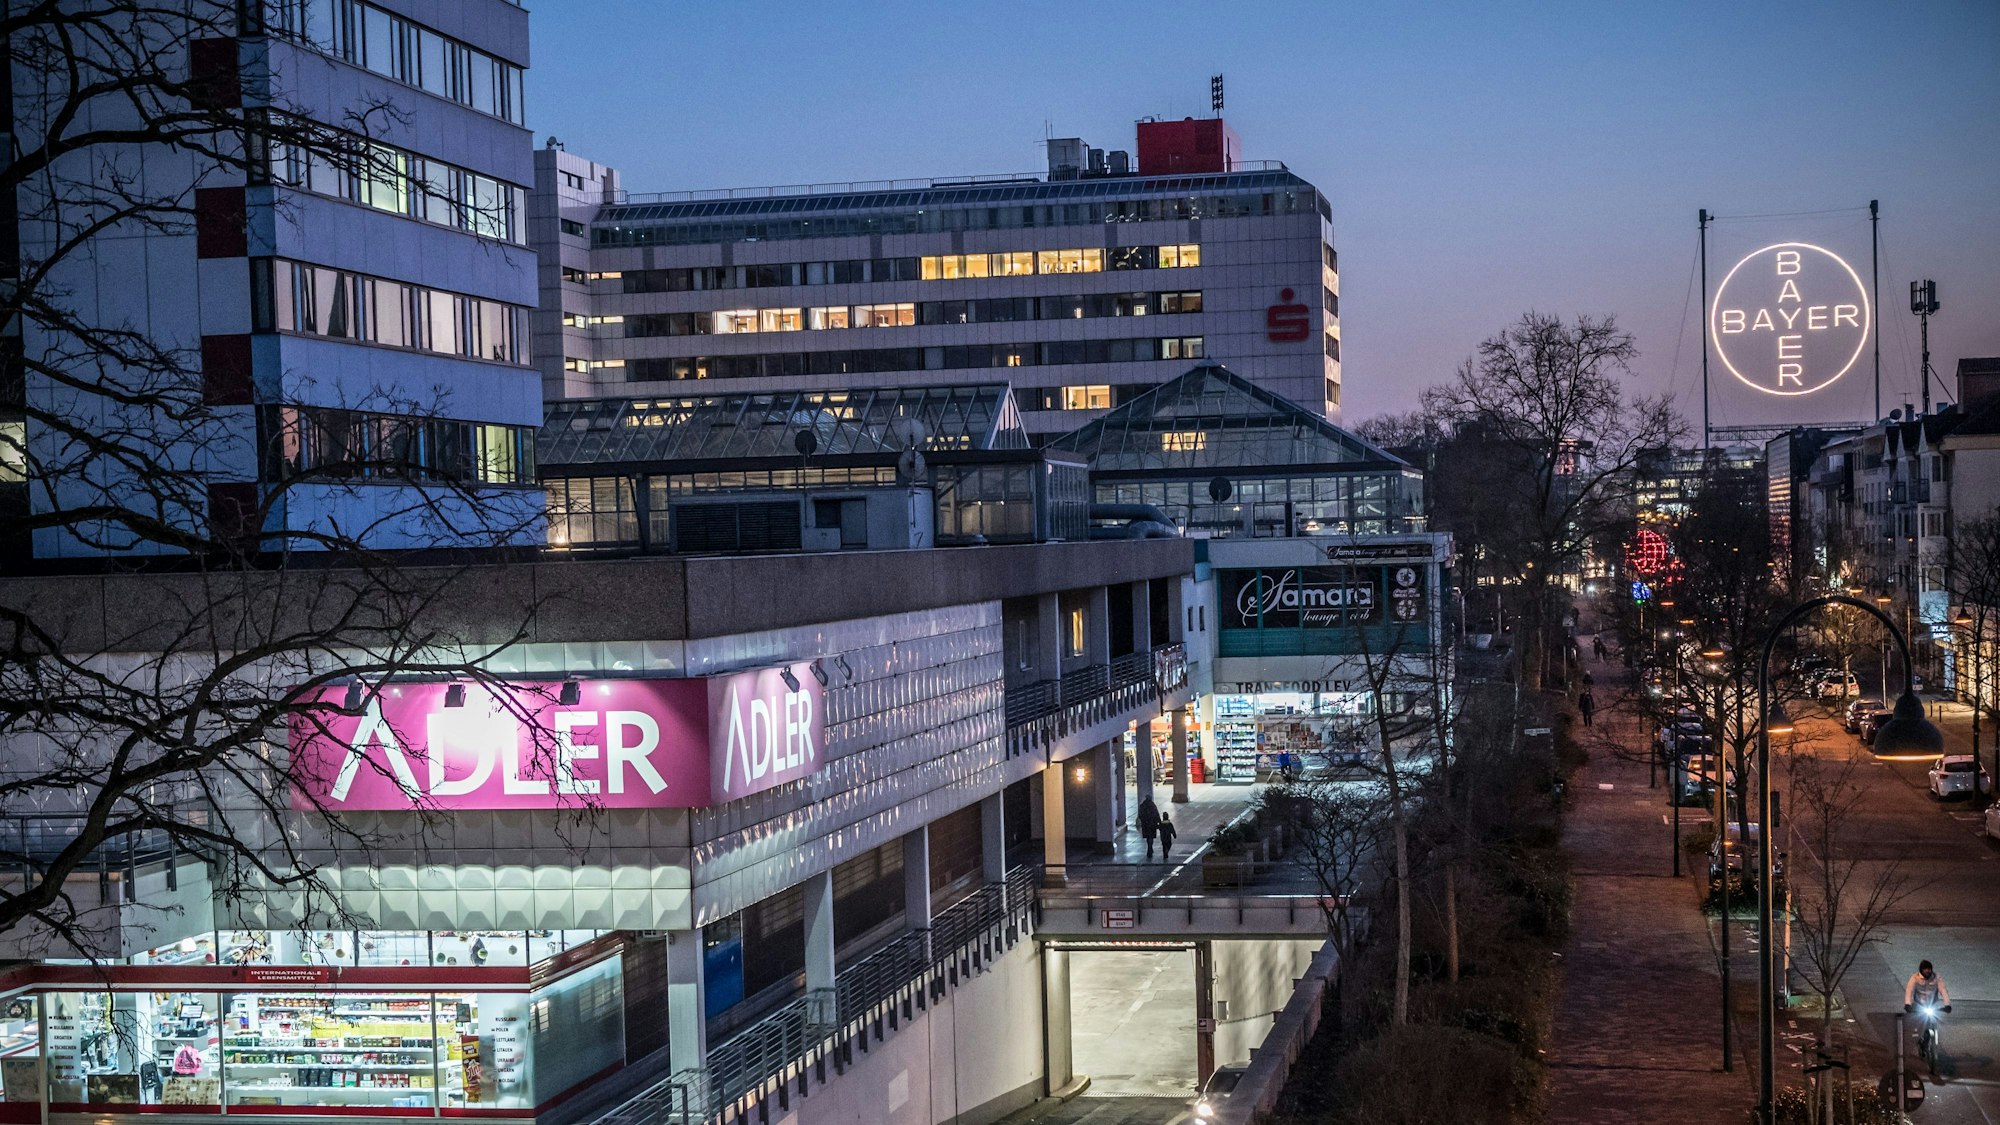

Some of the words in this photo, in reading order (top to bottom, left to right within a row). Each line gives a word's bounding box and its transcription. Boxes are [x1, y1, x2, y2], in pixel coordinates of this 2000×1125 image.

[1722, 304, 1859, 333] BAYER
[1777, 251, 1803, 387] BAYER
[1327, 547, 1361, 557] Samaa
[1237, 569, 1371, 626] Samara
[1303, 610, 1339, 627] lounge
[1236, 681, 1321, 694] TRANSFOOD
[1326, 681, 1351, 692] LEV
[330, 694, 668, 802] ADLER
[723, 682, 815, 793] ADLER
